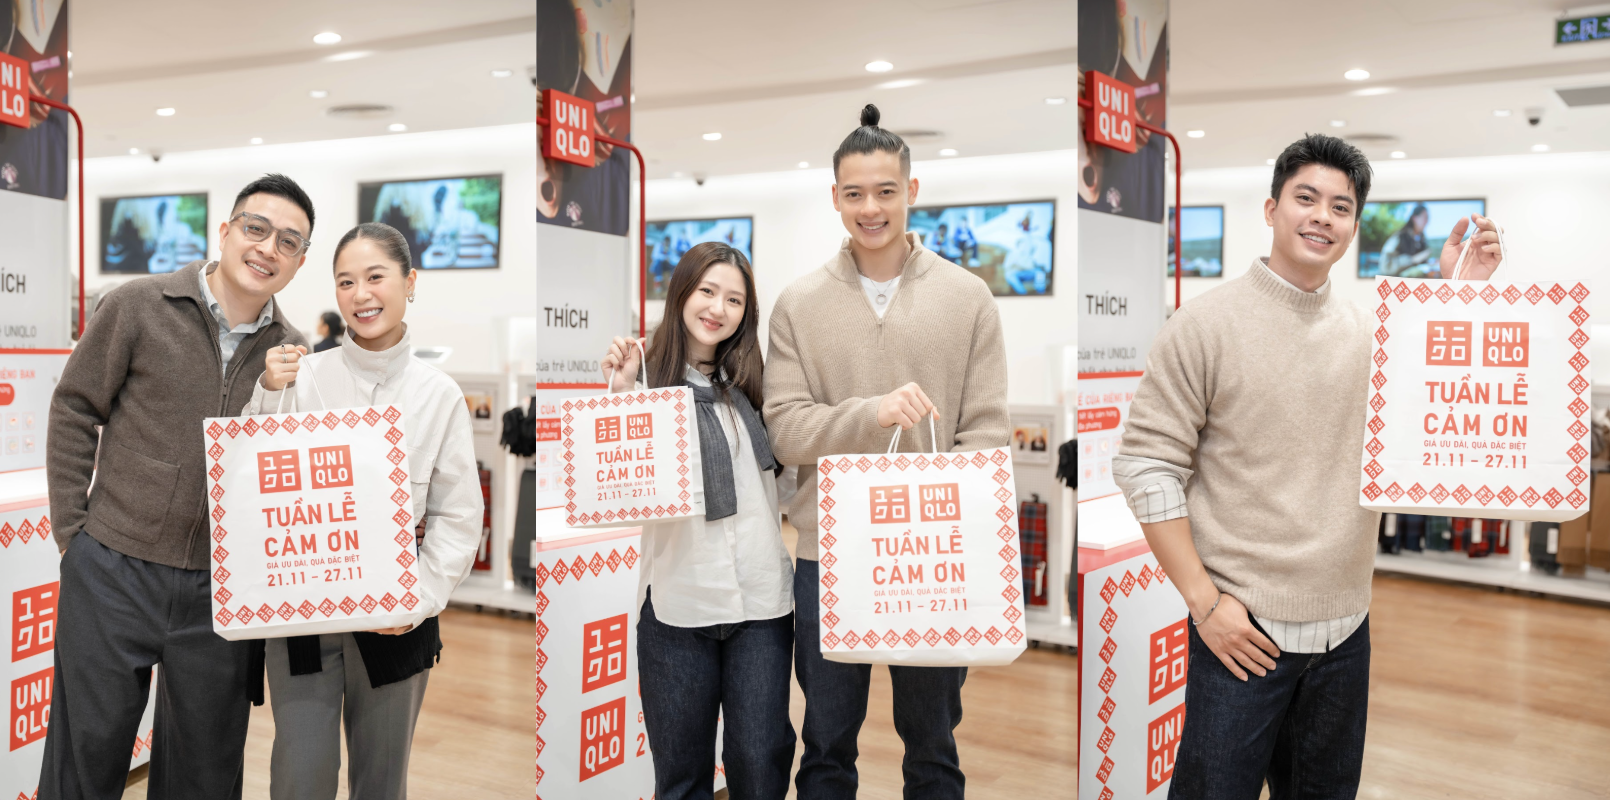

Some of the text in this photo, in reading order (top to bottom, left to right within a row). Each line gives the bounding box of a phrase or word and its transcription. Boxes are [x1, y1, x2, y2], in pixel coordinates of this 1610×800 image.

[1, 62, 21, 90] NI
[2, 90, 25, 118] LO
[1099, 82, 1128, 116] UNI
[556, 99, 587, 131] UNI
[1099, 112, 1132, 143] QLO
[556, 128, 590, 157] QLO
[1, 267, 26, 294] ÍCH
[1571, 285, 1583, 297] UNI
[1575, 289, 1588, 302] QLO
[1086, 290, 1128, 316] THÍCH
[544, 303, 588, 328] THÍCH
[4, 326, 37, 338] UNIQLO
[1433, 326, 1466, 342] ユニ
[1488, 328, 1520, 342] UNI
[1570, 331, 1582, 343] UNI
[1575, 335, 1587, 347] QLO
[1108, 347, 1136, 360] UNIQLO
[1431, 346, 1466, 360] クロ
[1488, 346, 1524, 364] QLO
[567, 360, 599, 373] UNIQLO
[1425, 372, 1528, 406] TUẦN LỄ
[1570, 377, 1582, 389] UNI
[1574, 381, 1587, 393] QLO
[598, 420, 618, 429] ユニ
[630, 416, 648, 426] UNI
[1424, 406, 1527, 437] CẢM ƠN
[1569, 422, 1581, 434] UNI
[598, 430, 618, 440] クロ
[630, 427, 650, 437] QLO
[1574, 426, 1586, 439] QLO
[1424, 439, 1437, 447] GIÁ
[1440, 440, 1451, 448] ƯU
[314, 450, 344, 466] UNI
[596, 442, 654, 464] TUẦN LỄ
[1423, 452, 1464, 466] 21.11
[1484, 454, 1526, 469] 27.11
[264, 454, 294, 470] ユニ
[264, 472, 296, 488] クロ
[316, 468, 348, 486] QLO
[597, 464, 655, 482] CẢM ƠN
[1568, 468, 1580, 479] UNI
[1573, 472, 1585, 484] QLO
[598, 491, 621, 501] 21.11
[632, 488, 656, 498] 27.11
[875, 488, 904, 502] ユニ
[923, 487, 952, 500] UNI
[262, 492, 357, 528] TUẦN LỄ
[874, 505, 906, 519] クロ
[924, 502, 956, 520] QLO
[20, 522, 28, 537] UNI
[23, 526, 32, 541] QLO
[264, 529, 360, 558] CẢM ƠN
[872, 526, 964, 557] TUẦN LỄ
[590, 555, 600, 569] UNI
[624, 549, 633, 562] UNI
[628, 553, 636, 567] QLO
[553, 562, 563, 577] UNI
[557, 566, 567, 582] QLO
[594, 559, 603, 574] QLO
[873, 559, 966, 585] CẢM ƠN
[267, 572, 306, 586] 21.11
[324, 566, 362, 582] 27.11
[400, 572, 410, 583] UNI
[404, 576, 415, 588] QLO
[1121, 573, 1131, 590] UNI
[1124, 577, 1135, 594] QLO
[18, 591, 54, 622] ユニ
[361, 597, 372, 608] UNI
[365, 600, 376, 612] QLO
[402, 593, 412, 605] UNI
[406, 597, 417, 609] QLO
[874, 600, 911, 614] 21.11
[930, 599, 968, 612] 27.11
[1005, 607, 1015, 618] UNI
[1009, 611, 1020, 622] QLO
[1101, 609, 1112, 626] UNI
[1105, 613, 1116, 631] QLO
[17, 620, 54, 652] クロ
[589, 623, 622, 654] ユニ
[965, 629, 976, 639] UNI
[969, 633, 980, 644] QLO
[1007, 628, 1017, 638] UNI
[1011, 632, 1022, 643] QLO
[1155, 628, 1185, 664] ユニ
[588, 651, 621, 684] クロ
[1153, 656, 1184, 694] クロ
[1100, 669, 1111, 687] UNI
[1104, 673, 1115, 691] QLO
[16, 676, 50, 710] UNI
[586, 708, 618, 740] UNI
[1152, 713, 1181, 750] UNI
[1099, 729, 1110, 747] UNI
[1103, 733, 1114, 751] QLO
[585, 736, 620, 772] QLO
[1151, 742, 1178, 782] QL
